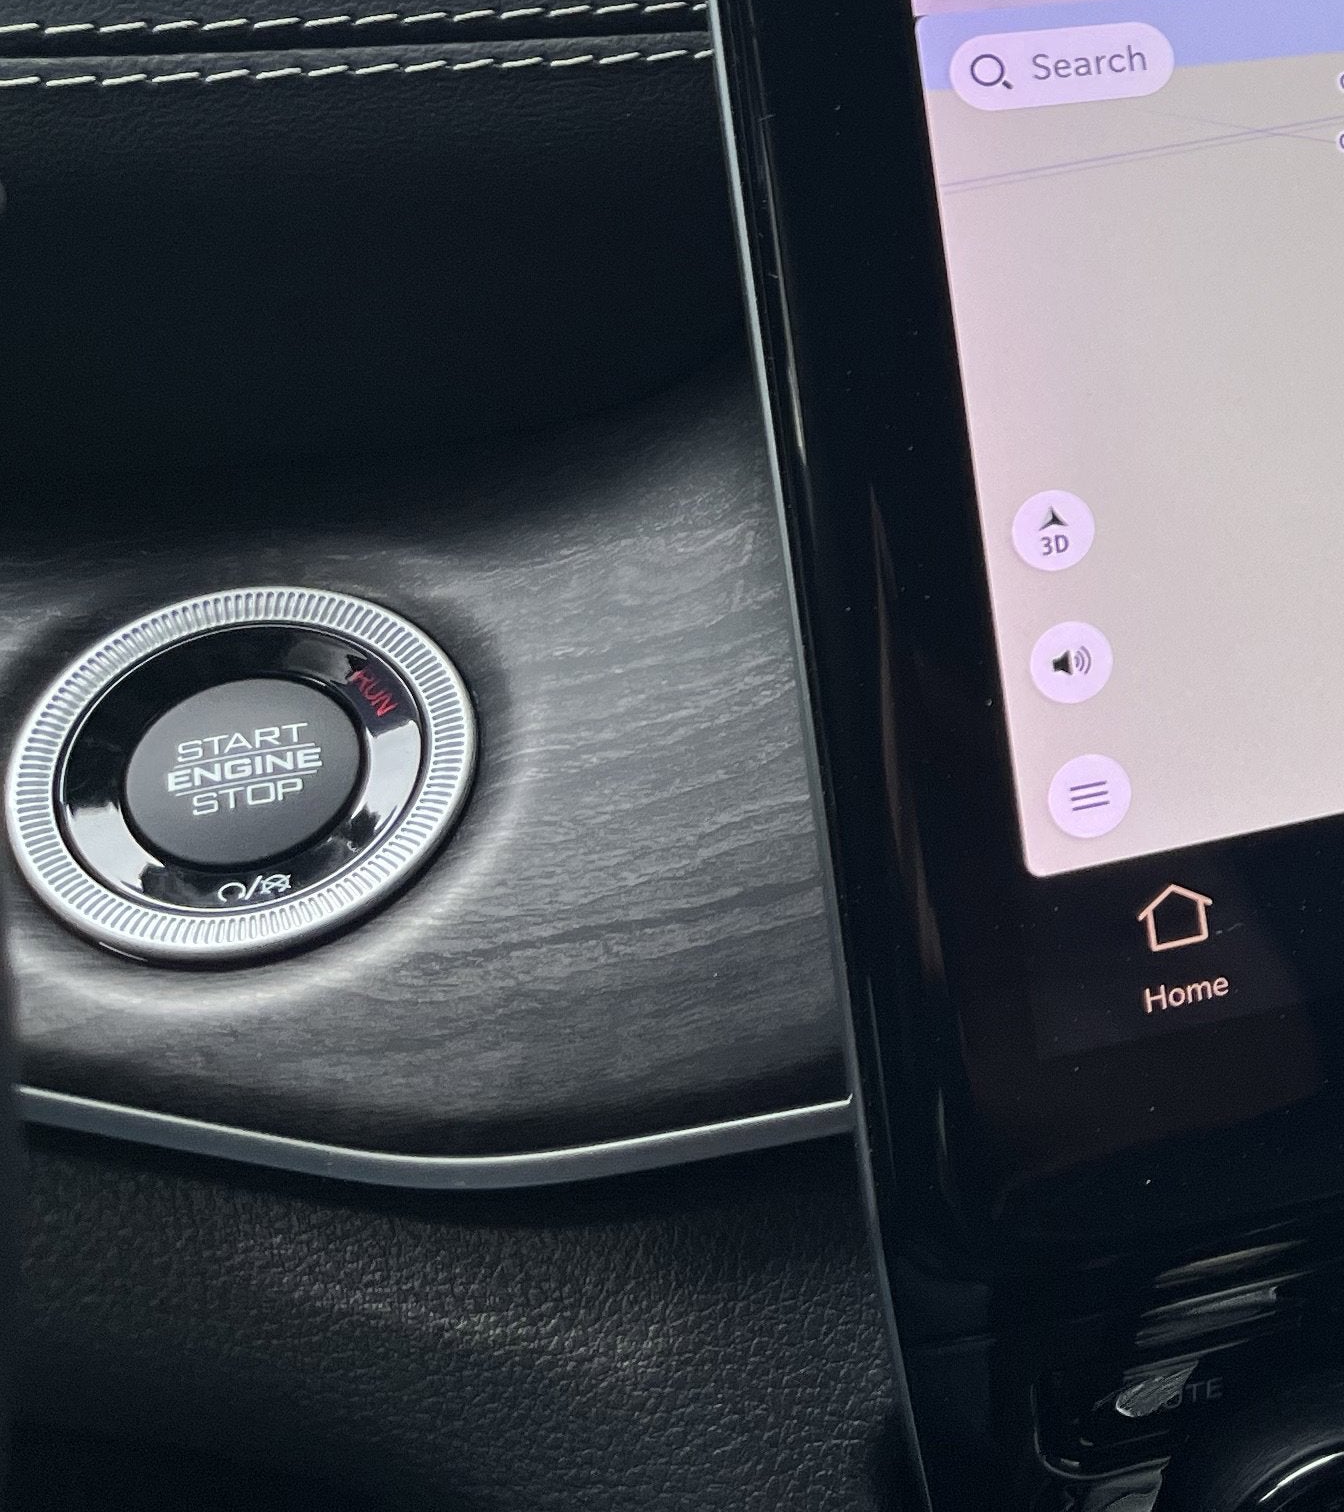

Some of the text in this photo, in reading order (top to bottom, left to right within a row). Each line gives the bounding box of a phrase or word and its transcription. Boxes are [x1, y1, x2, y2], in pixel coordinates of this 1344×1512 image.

[1031, 43, 1148, 83] Search
[1040, 534, 1070, 556] 3D
[351, 667, 398, 718] RUN
[177, 721, 310, 763] START
[167, 745, 322, 792] ENGINE
[192, 777, 304, 817] STOP
[1143, 974, 1230, 1014] Home
